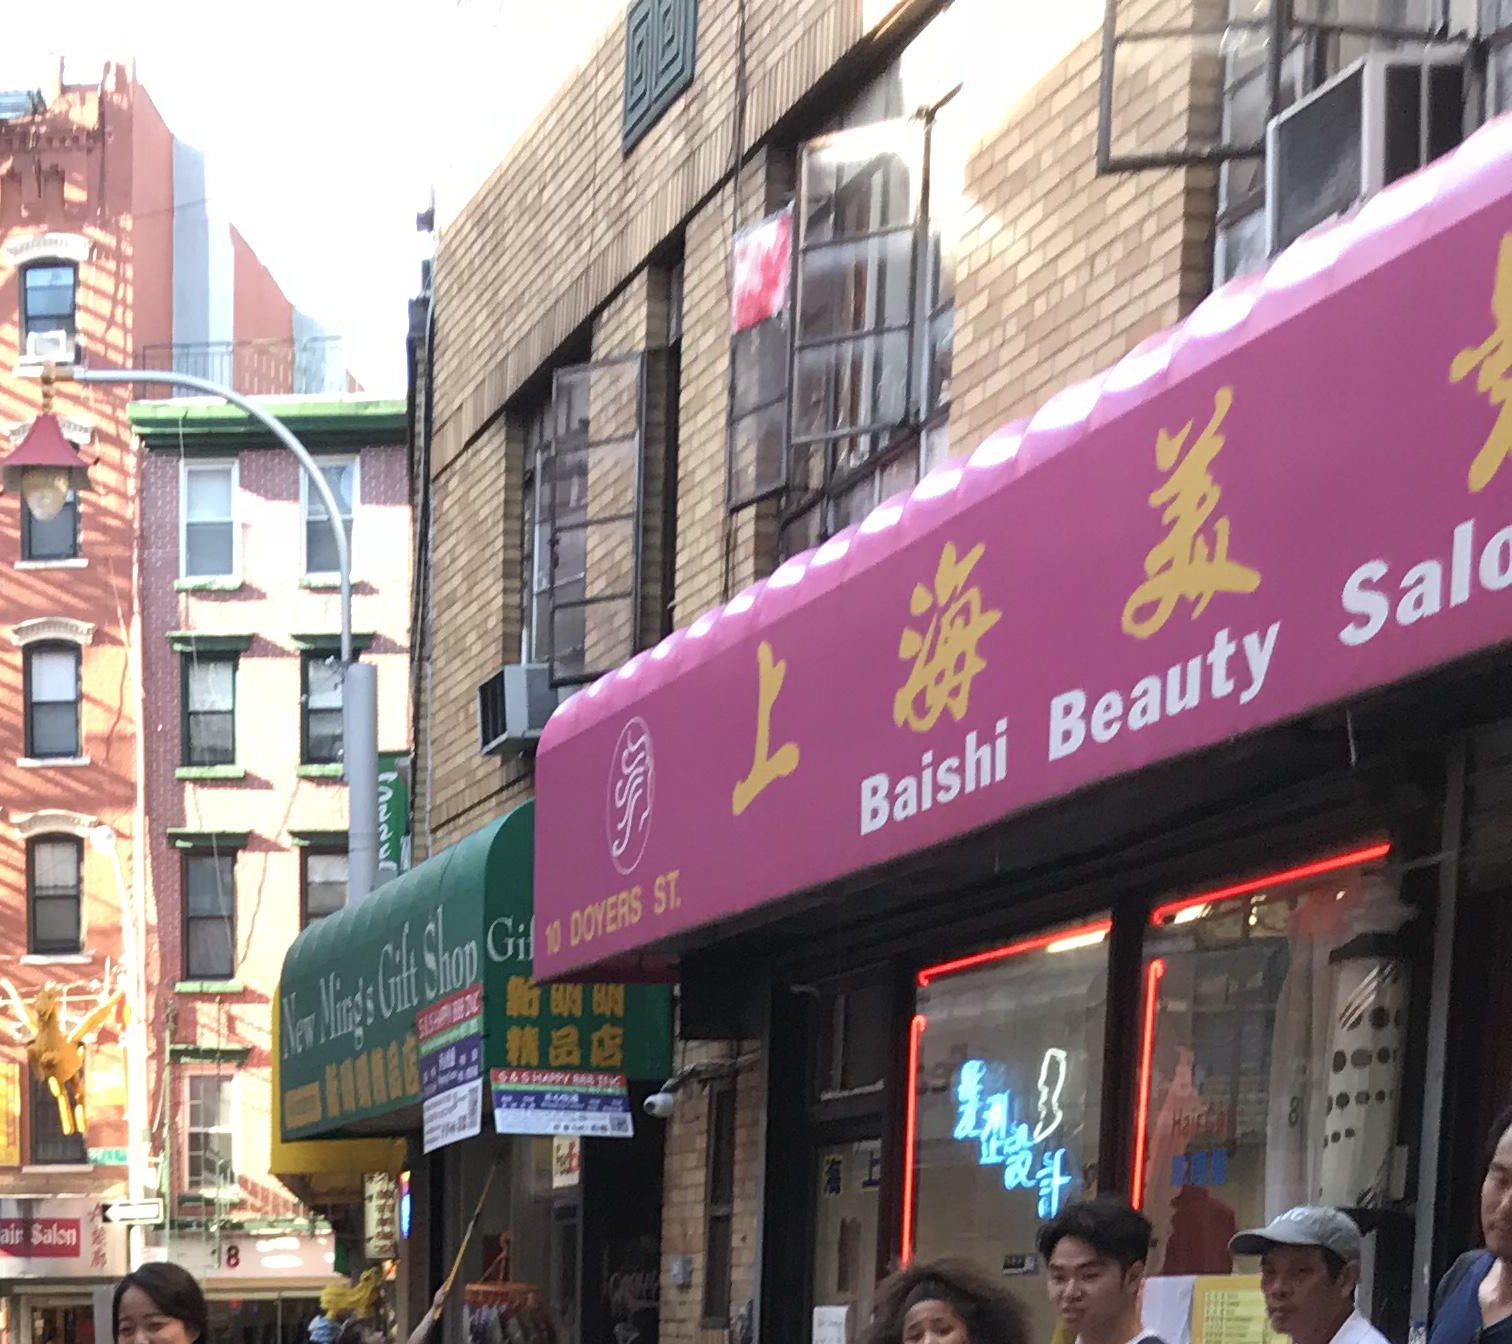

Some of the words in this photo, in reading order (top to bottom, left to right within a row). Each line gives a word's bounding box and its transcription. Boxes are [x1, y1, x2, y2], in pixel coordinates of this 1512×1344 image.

[860, 718, 1008, 836] Baishi
[1047, 620, 1281, 763] Beauty
[545, 919, 561, 955] 10
[570, 885, 642, 947] DOYERS
[653, 870, 681, 915] ST.
[283, 991, 316, 1060] New
[319, 972, 374, 1051] Ming's
[378, 920, 418, 1020] Gift
[423, 904, 478, 1000] Shop
[31, 1221, 76, 1246] Salon
